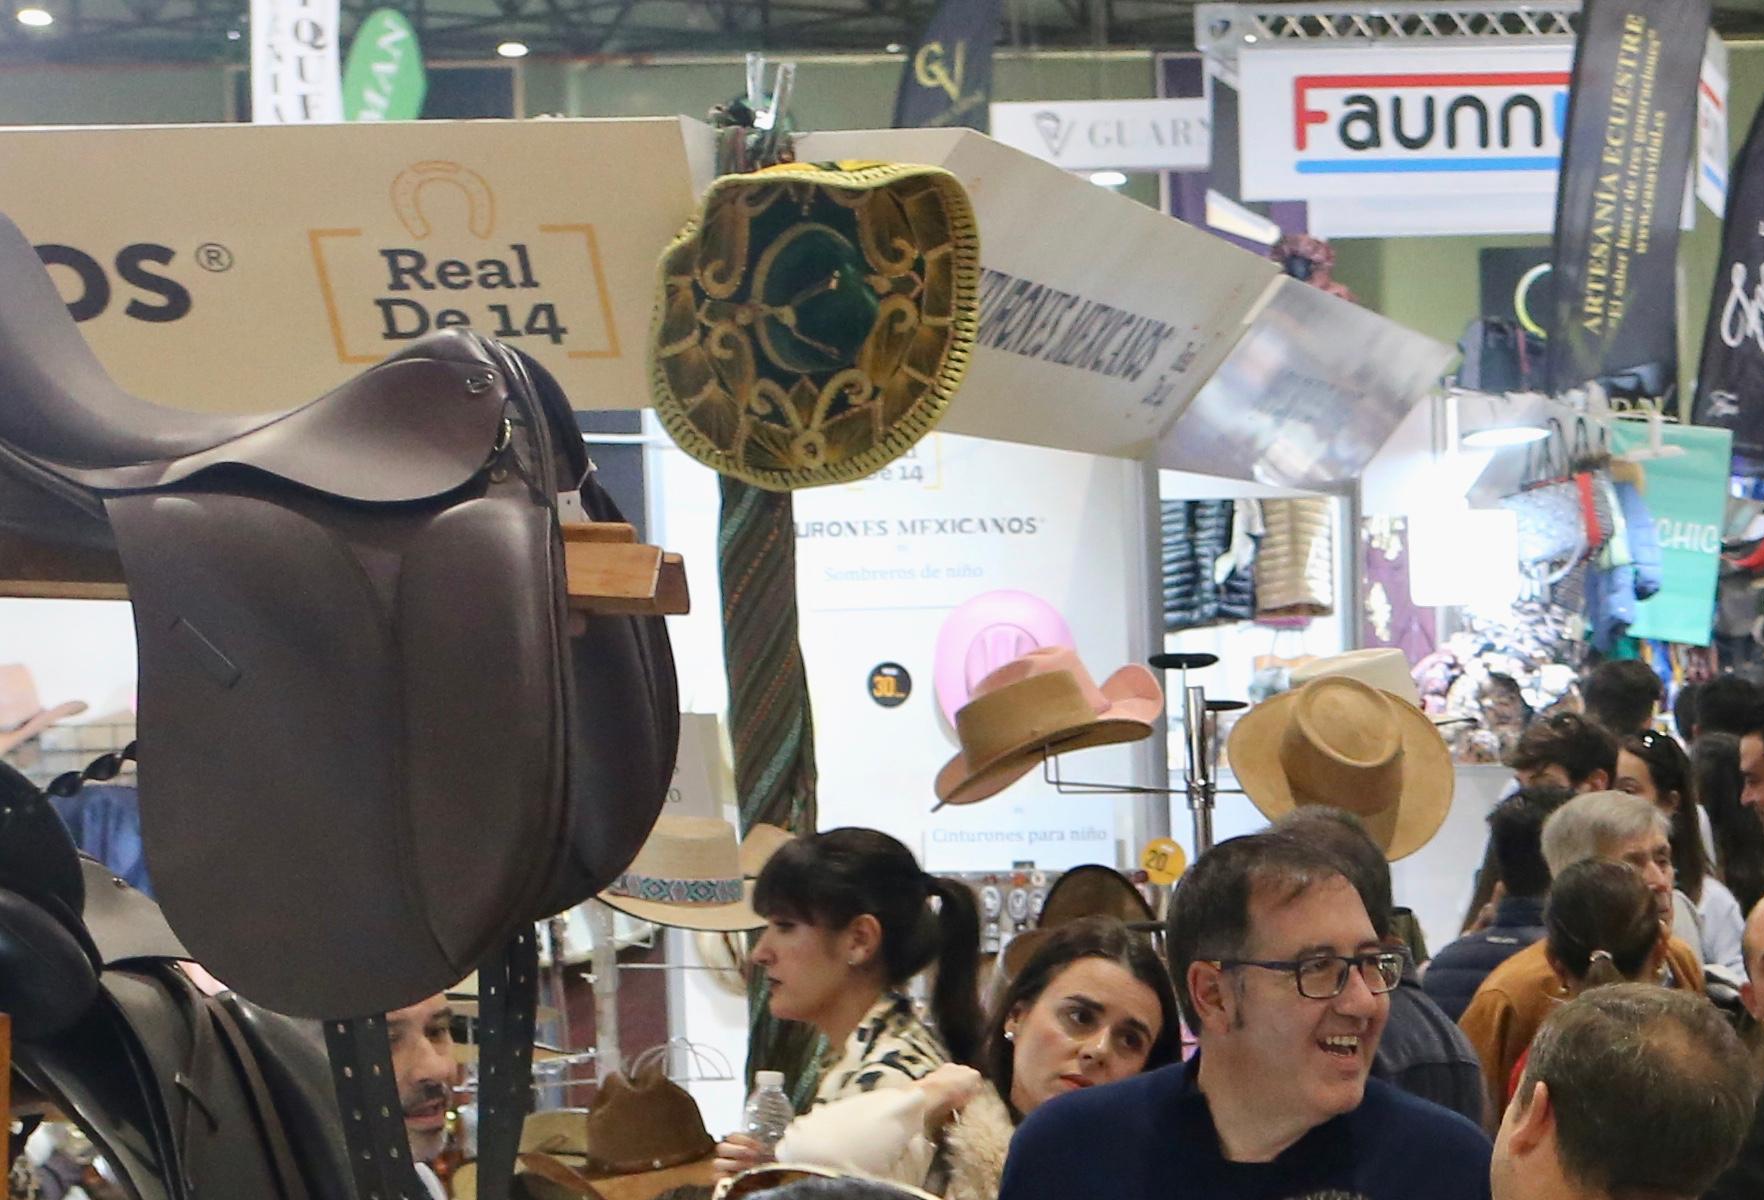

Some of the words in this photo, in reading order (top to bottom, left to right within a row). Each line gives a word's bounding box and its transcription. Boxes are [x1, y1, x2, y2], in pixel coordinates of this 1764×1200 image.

[1583, 173, 1620, 335] ARTESANÍA
[1602, 13, 1647, 165] ECUESTRE
[1627, 146, 1642, 176] tres
[1623, 180, 1637, 200] de
[379, 243, 541, 291] Real
[1612, 252, 1629, 297] saber
[373, 297, 471, 340] De
[487, 302, 569, 345] 14
[899, 465, 924, 483] 14
[824, 566, 915, 582] Sombreros
[920, 564, 941, 579] de
[946, 563, 984, 579] niño
[932, 828, 1024, 844] Cinturones
[1028, 831, 1065, 846] para
[1070, 827, 1107, 842] niño
